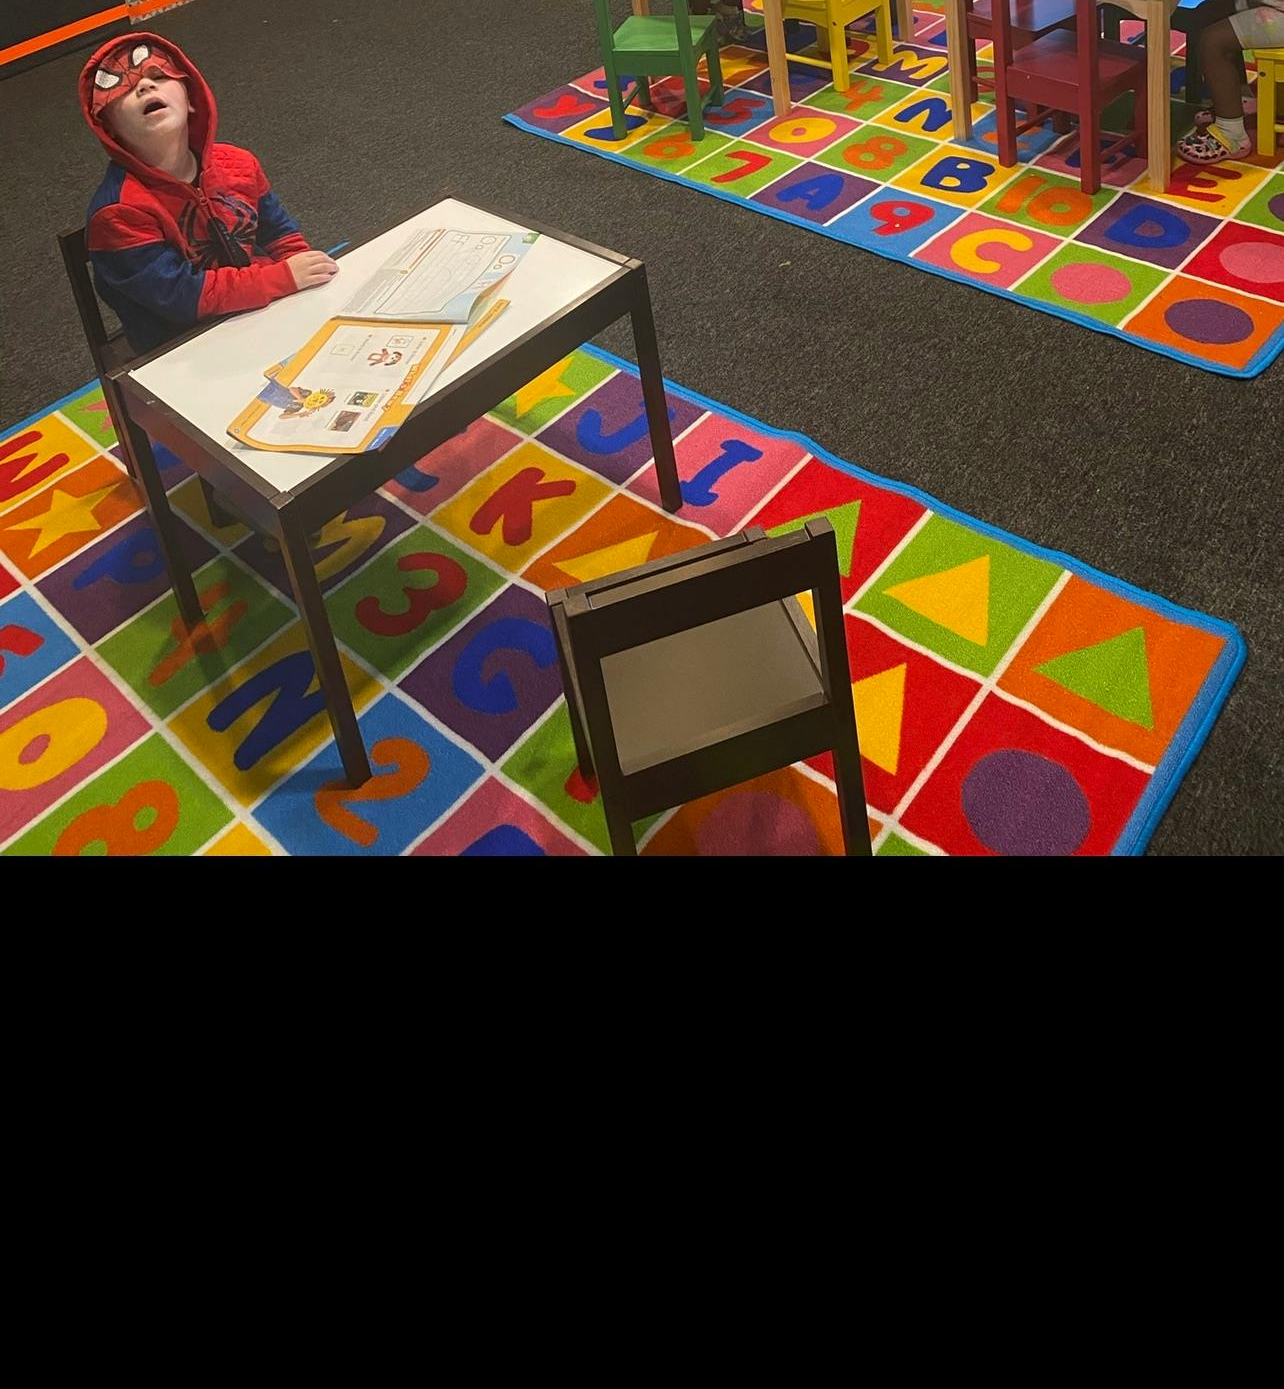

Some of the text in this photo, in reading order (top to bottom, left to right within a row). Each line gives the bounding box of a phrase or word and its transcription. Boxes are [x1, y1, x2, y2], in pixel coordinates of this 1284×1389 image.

[872, 49, 949, 80] M
[532, 94, 597, 120] Y
[704, 97, 767, 125] 5
[841, 80, 885, 112] 4
[642, 131, 696, 161] 6
[842, 135, 908, 171] 8
[710, 149, 773, 184] 7
[920, 155, 996, 193] B
[1168, 163, 1243, 203] E
[775, 172, 844, 210] A
[994, 173, 1093, 227] 10
[869, 200, 935, 237] 9
[1103, 201, 1192, 249] D
[950, 228, 1034, 275] C
[680, 439, 764, 507] I
[468, 466, 576, 547] K
[354, 551, 468, 637] 3
[451, 615, 559, 716] G
[313, 737, 431, 848] 2
[52, 778, 181, 857] 8
